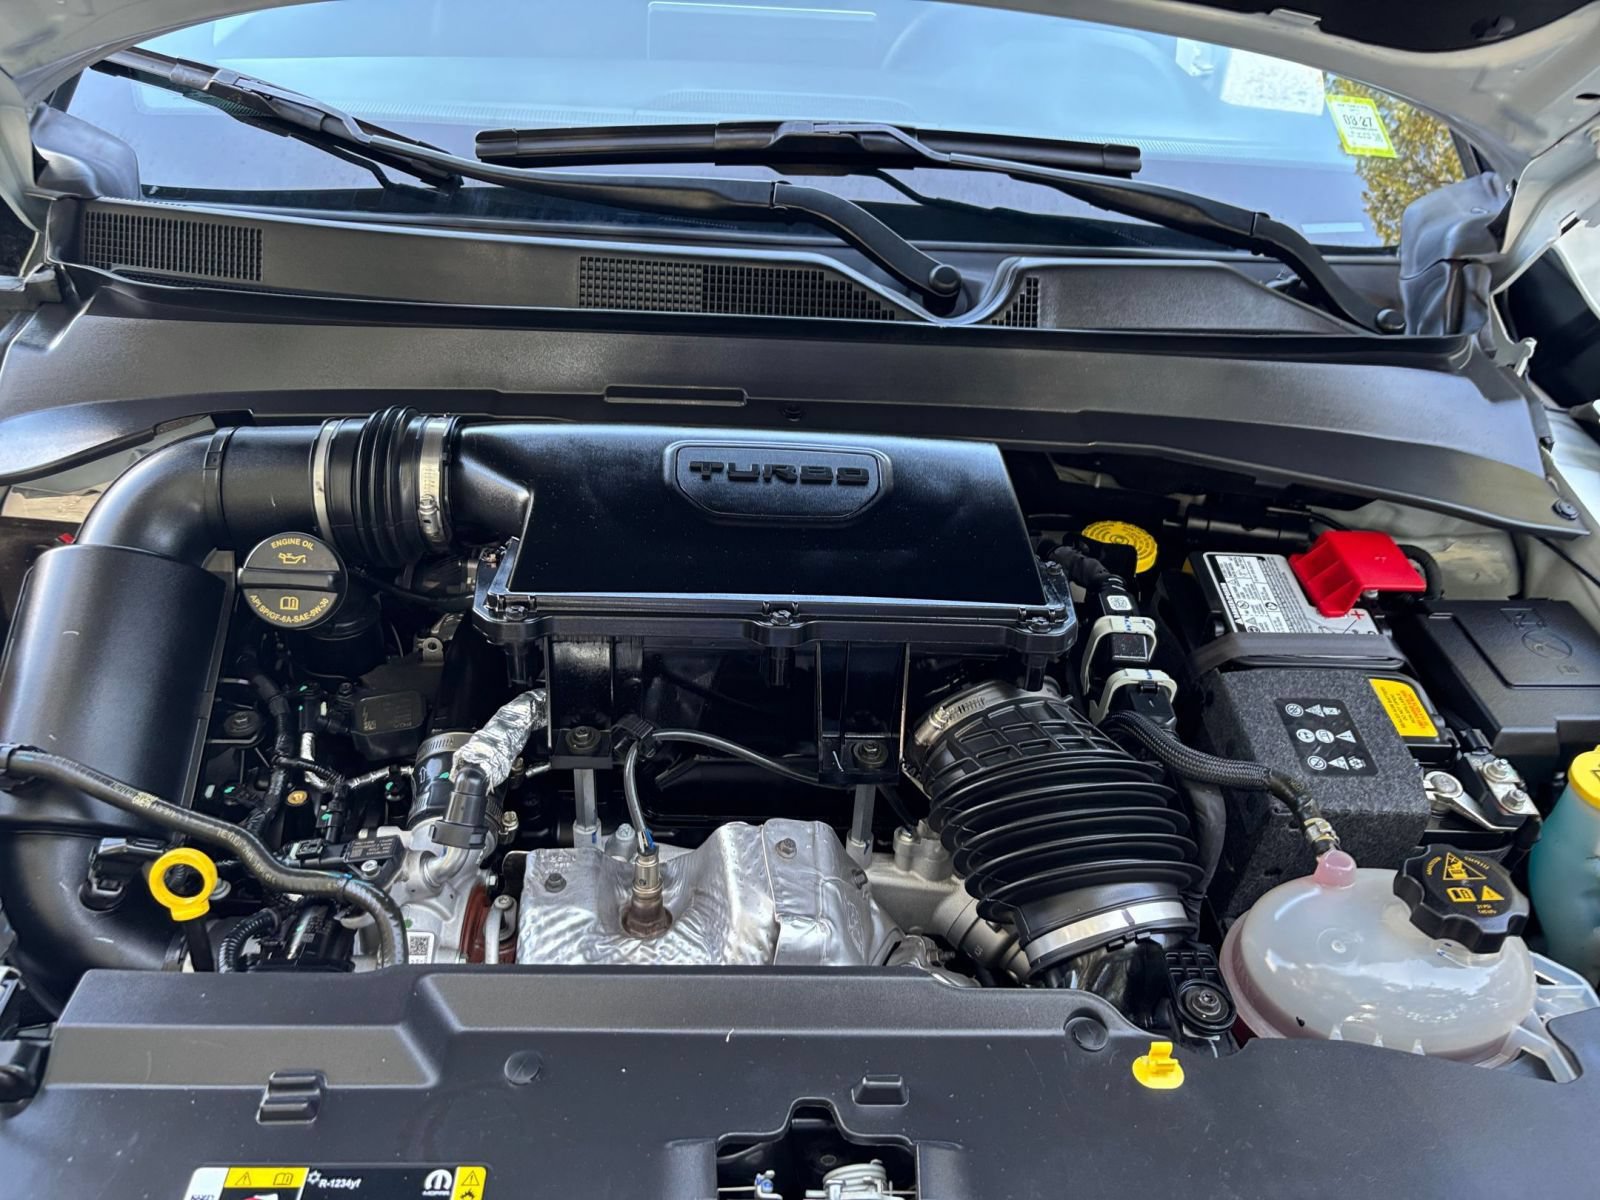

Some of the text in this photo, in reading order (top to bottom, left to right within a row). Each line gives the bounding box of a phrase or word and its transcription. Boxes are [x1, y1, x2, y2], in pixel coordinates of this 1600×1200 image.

[689, 460, 870, 484] TURBO
[271, 537, 315, 551] ENGINE OIL
[250, 595, 261, 608] API
[318, 1178, 362, 1190] R-1234yf
